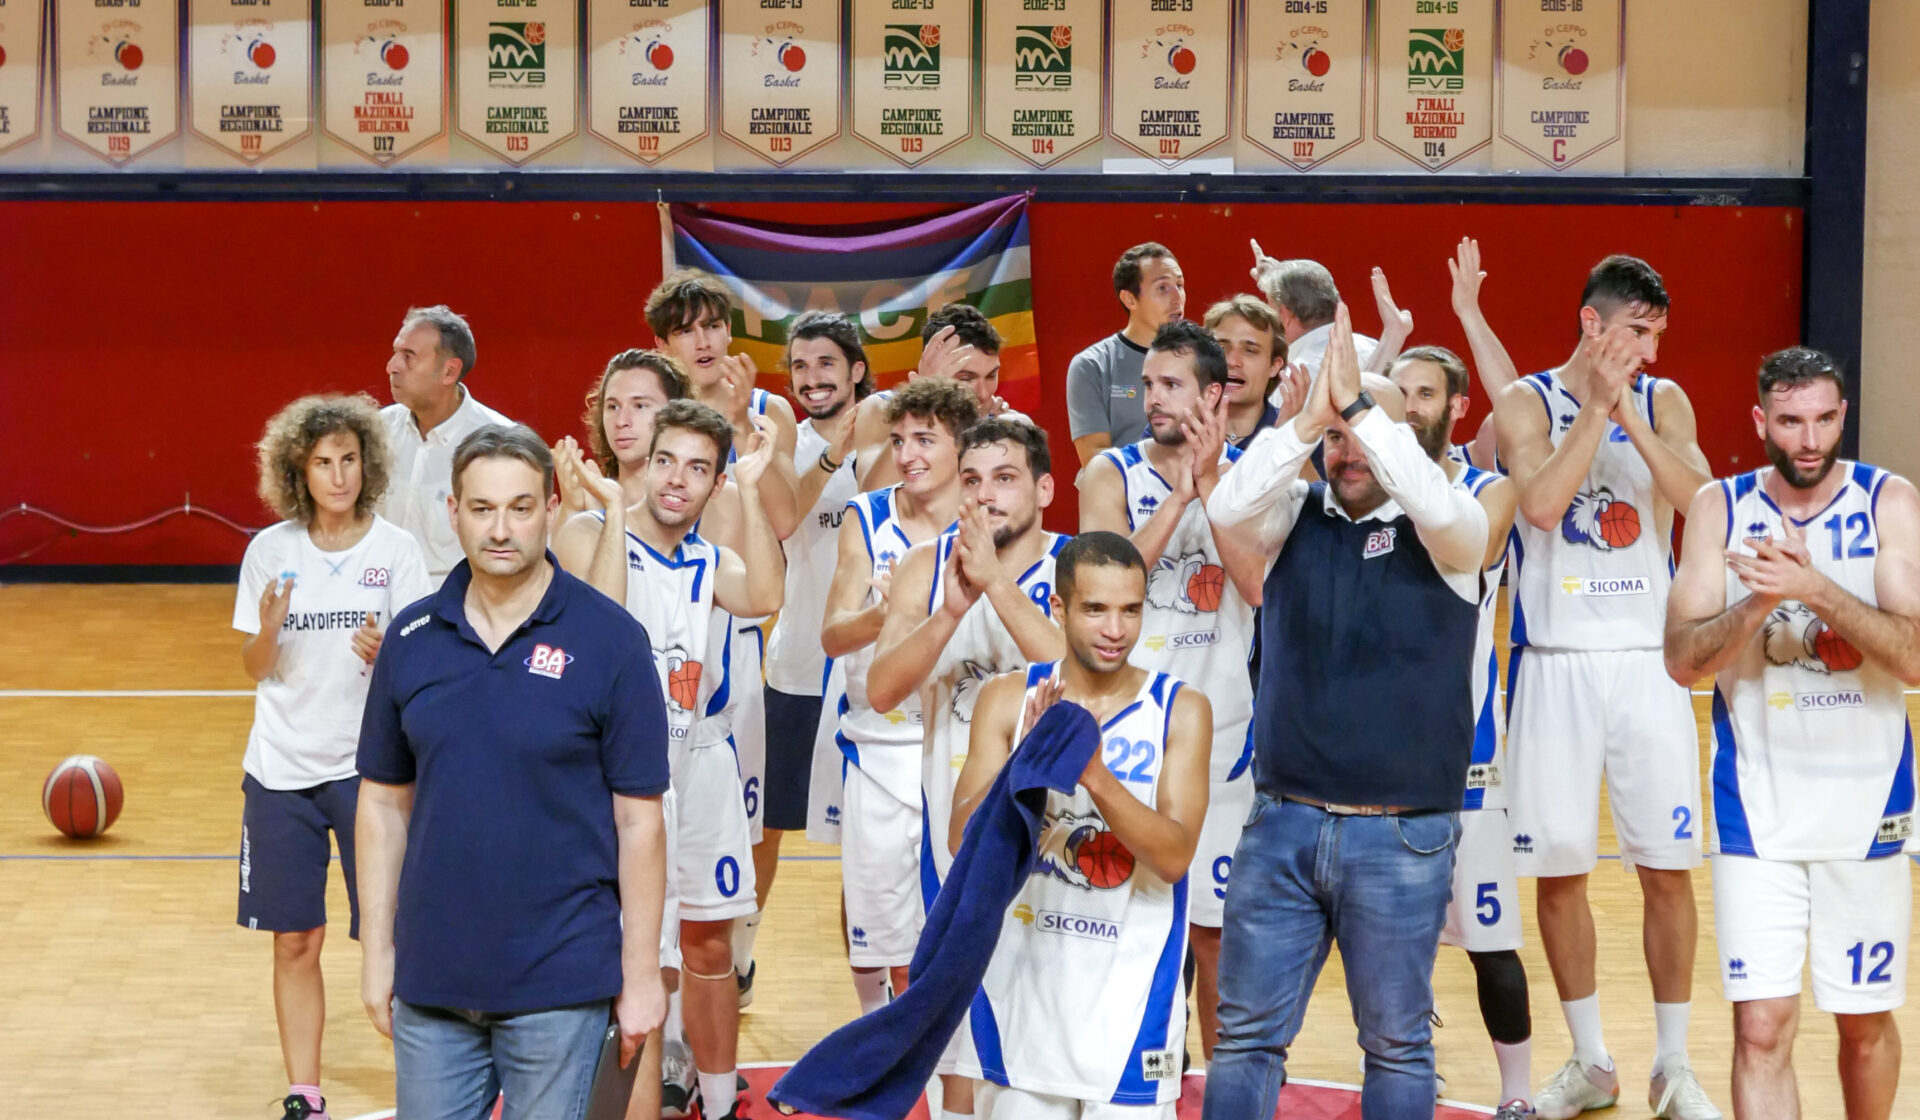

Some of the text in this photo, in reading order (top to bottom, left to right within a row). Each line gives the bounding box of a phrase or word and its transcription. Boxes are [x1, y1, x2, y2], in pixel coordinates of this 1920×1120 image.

[1151, 0, 1193, 12] 2012-13
[1285, 1, 1327, 13] 2014-15
[1416, 1, 1458, 14] 2014-15
[1541, 0, 1583, 12] 2015-16
[1289, 27, 1299, 38] DI
[1301, 26, 1329, 39] CEPPO
[101, 73, 138, 86] Basket
[234, 72, 270, 85] Basket
[366, 72, 404, 86] Basket
[489, 72, 546, 83] PVB
[632, 73, 668, 86] Basket
[764, 74, 801, 88] Basket
[884, 73, 940, 85] PVB
[1016, 75, 1072, 86] PVB
[1154, 77, 1190, 90] Basket
[1408, 78, 1463, 89] PVB
[1543, 77, 1582, 90] Basket
[1288, 79, 1325, 93] Basket
[365, 92, 403, 105] FINALI
[1417, 98, 1454, 111] FINALI
[89, 107, 148, 119] CAMPIONE
[221, 105, 281, 119] CAMPIONE
[354, 106, 414, 119] NAZIONALI
[487, 107, 547, 119] CAMPIONE
[619, 107, 678, 119] CAMPIONE
[751, 108, 810, 121] CAMPIONE
[883, 109, 941, 121] CAMPIONE
[1014, 110, 1073, 122] CAMPIONE
[1141, 110, 1200, 123] CAMPIONE
[1406, 112, 1464, 125] NAZIONALI
[1531, 111, 1590, 124] CAMPIONE
[219, 119, 283, 132] REGIONALE
[1275, 113, 1334, 126] CAMPIONE
[88, 121, 150, 134] REGIONALE
[358, 120, 410, 133] BOLOGNA
[486, 121, 549, 133] REGIONALE
[618, 121, 680, 133] REGIONALE
[749, 122, 812, 135] REGIONALE
[881, 123, 943, 135] REGIONALE
[1012, 124, 1074, 136] REGIONALE
[1139, 124, 1201, 137] REGIONALE
[1273, 127, 1335, 139] REGIONALE
[1413, 126, 1457, 139] BORMIO
[1543, 125, 1577, 137] SERIE
[108, 136, 130, 151] U19
[241, 135, 262, 150] U17
[374, 136, 395, 151] U17
[506, 136, 529, 151] U13
[639, 136, 660, 150] U17
[770, 137, 792, 152] U13
[901, 138, 923, 152] U13
[1032, 139, 1054, 154] U14
[1159, 139, 1181, 154] U17
[1293, 142, 1314, 157] U17
[1424, 142, 1445, 157] U14
[1553, 139, 1566, 162] C
[1367, 531, 1391, 552] BA
[1824, 512, 1875, 561] 12
[364, 567, 389, 587] BA
[683, 558, 706, 603] 7
[1589, 579, 1645, 594] SICOMA
[283, 611, 381, 631] #PLAYDIFFERET
[532, 644, 565, 675] BA
[1801, 693, 1863, 707] SICOMA
[1106, 736, 1154, 782] 22
[744, 776, 759, 818] 6
[1672, 806, 1692, 840] 2
[715, 856, 740, 898] 0
[1212, 856, 1233, 899] 9
[1476, 882, 1501, 926] 5
[1043, 915, 1119, 939] SICOMA
[1847, 942, 1895, 985] 12
